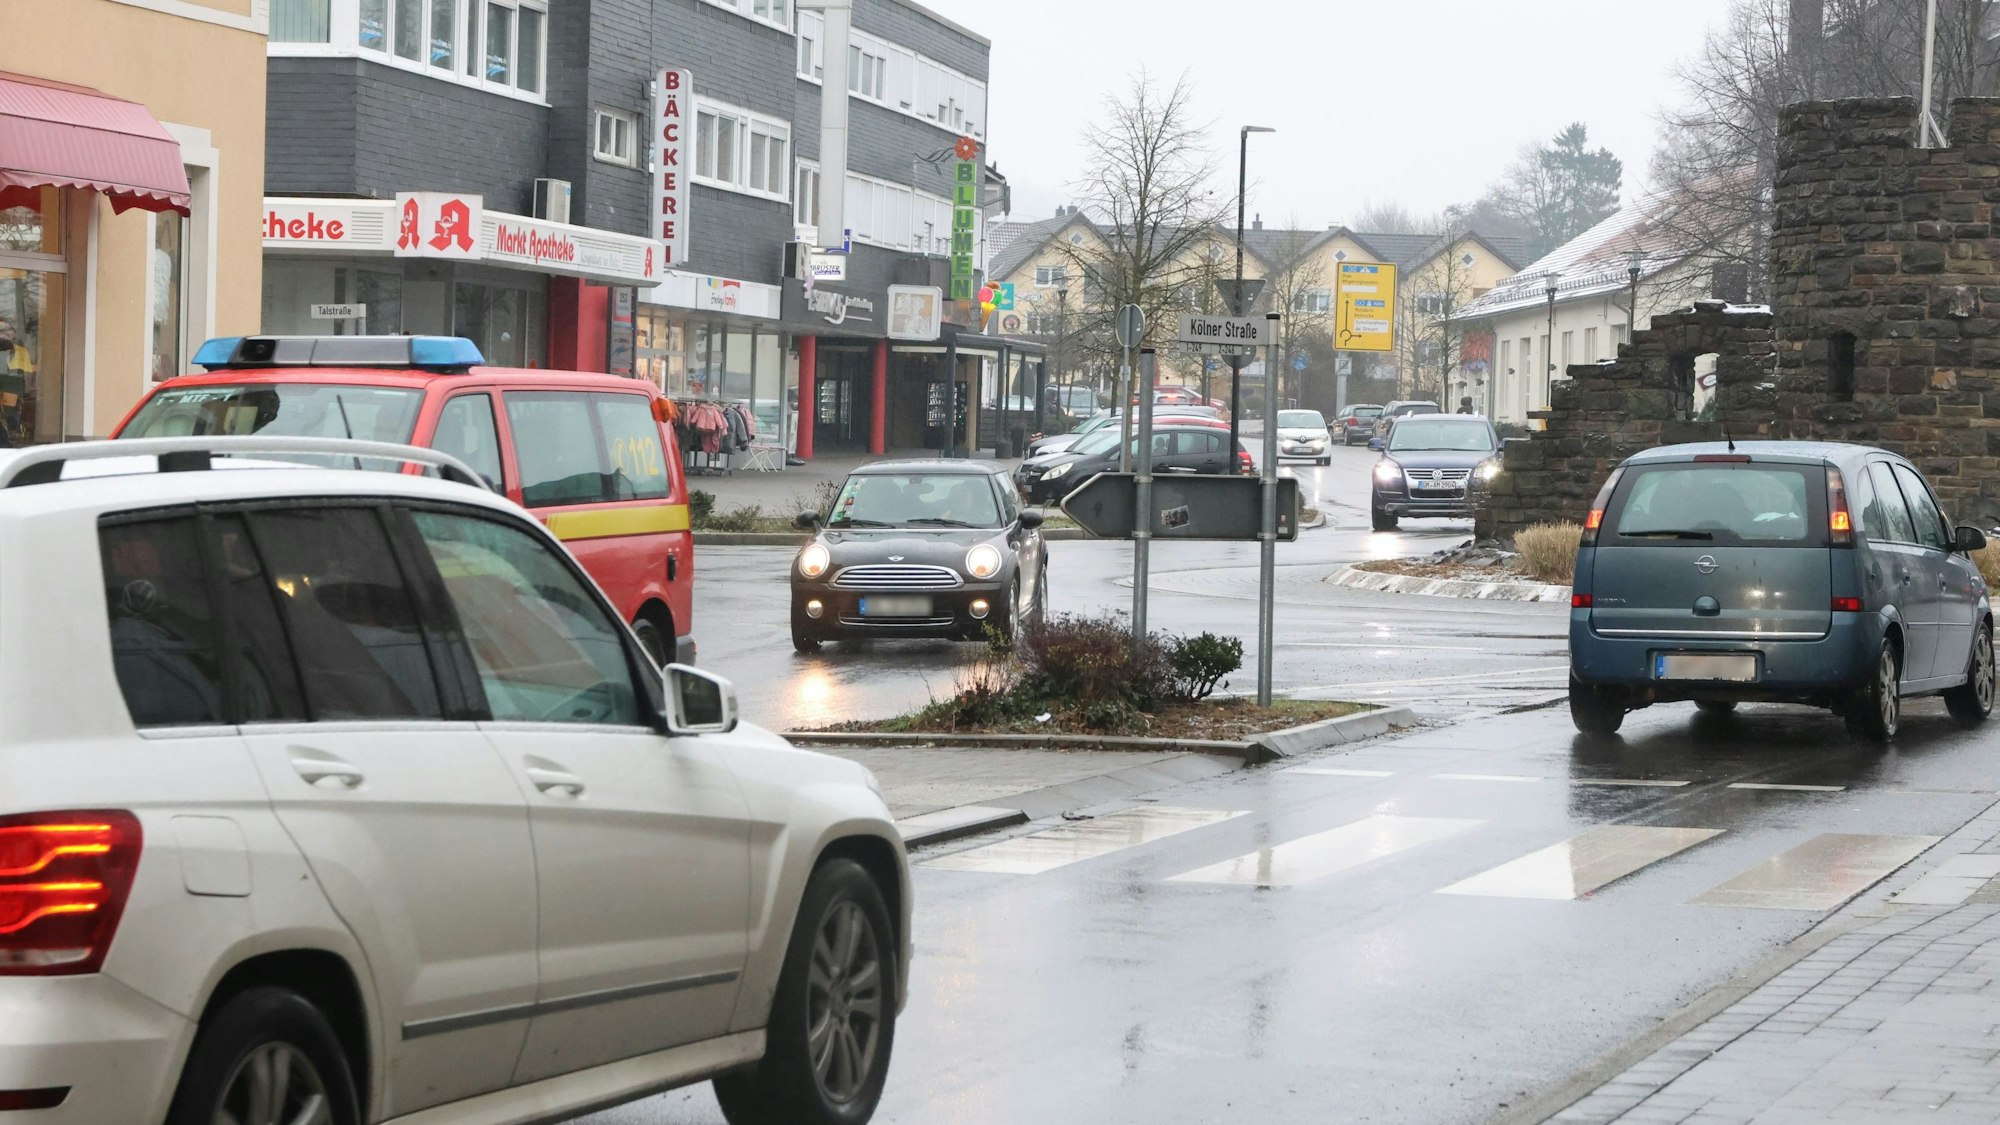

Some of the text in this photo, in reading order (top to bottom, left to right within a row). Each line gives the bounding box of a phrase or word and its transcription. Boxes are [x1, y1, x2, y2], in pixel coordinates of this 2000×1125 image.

[662, 71, 680, 263] BÄCKEREI
[496, 224, 527, 255] Markt
[529, 229, 574, 264] Apotheke
[952, 163, 972, 299] BLUMEN
[318, 306, 352, 316] Talstraße
[1190, 318, 1257, 339] Kölner Straße
[179, 394, 209, 404] MTF
[629, 436, 660, 476] 112
